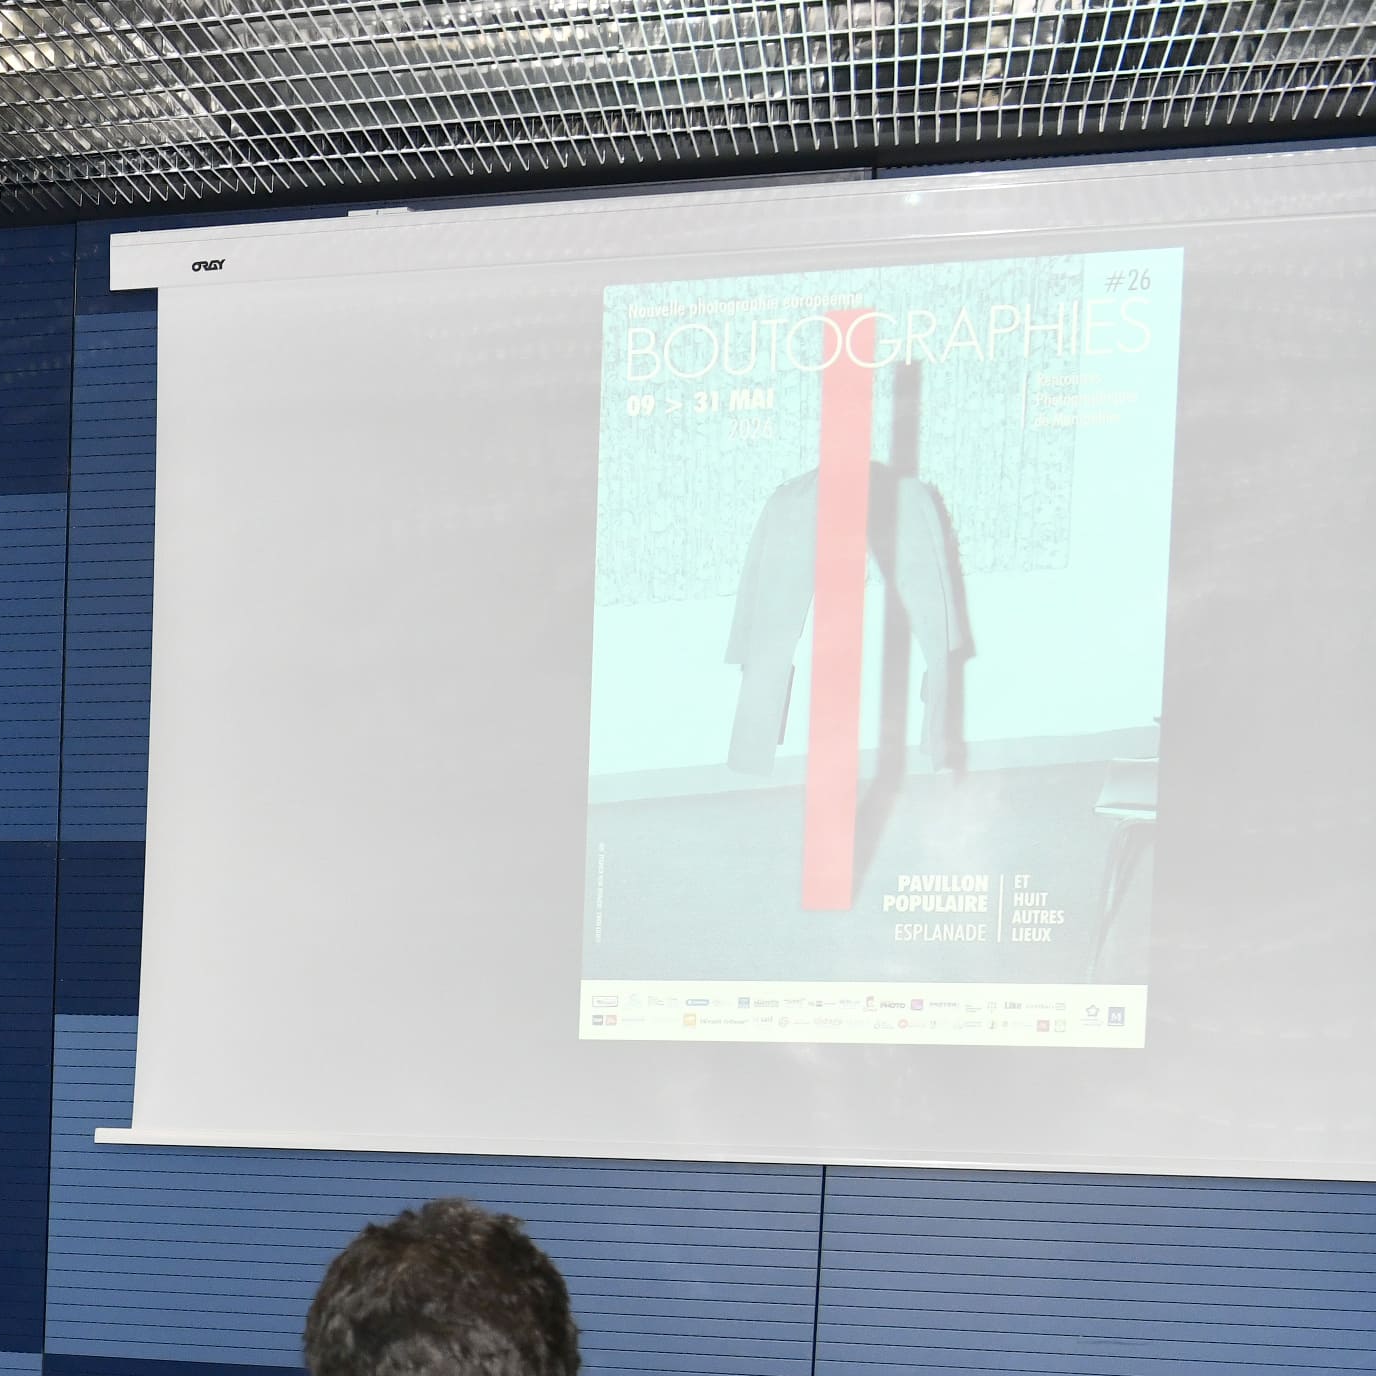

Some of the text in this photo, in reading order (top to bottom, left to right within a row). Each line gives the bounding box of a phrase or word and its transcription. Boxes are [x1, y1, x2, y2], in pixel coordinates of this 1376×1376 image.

[1104, 268, 1152, 293] #26
[627, 302, 685, 319] Nouvelle
[626, 296, 1153, 382] BOUTOGRAPHIES
[626, 394, 656, 417] 09
[693, 390, 719, 413] 31
[728, 386, 775, 412] MAI
[898, 874, 990, 893] PAVILLON
[1014, 874, 1032, 889] ET
[883, 894, 988, 913] POPULAIRE
[1013, 892, 1049, 907] HUIT
[1011, 909, 1065, 925] AUTRES
[894, 923, 987, 942] ESPLANADE
[1011, 927, 1052, 943] LIEUX
